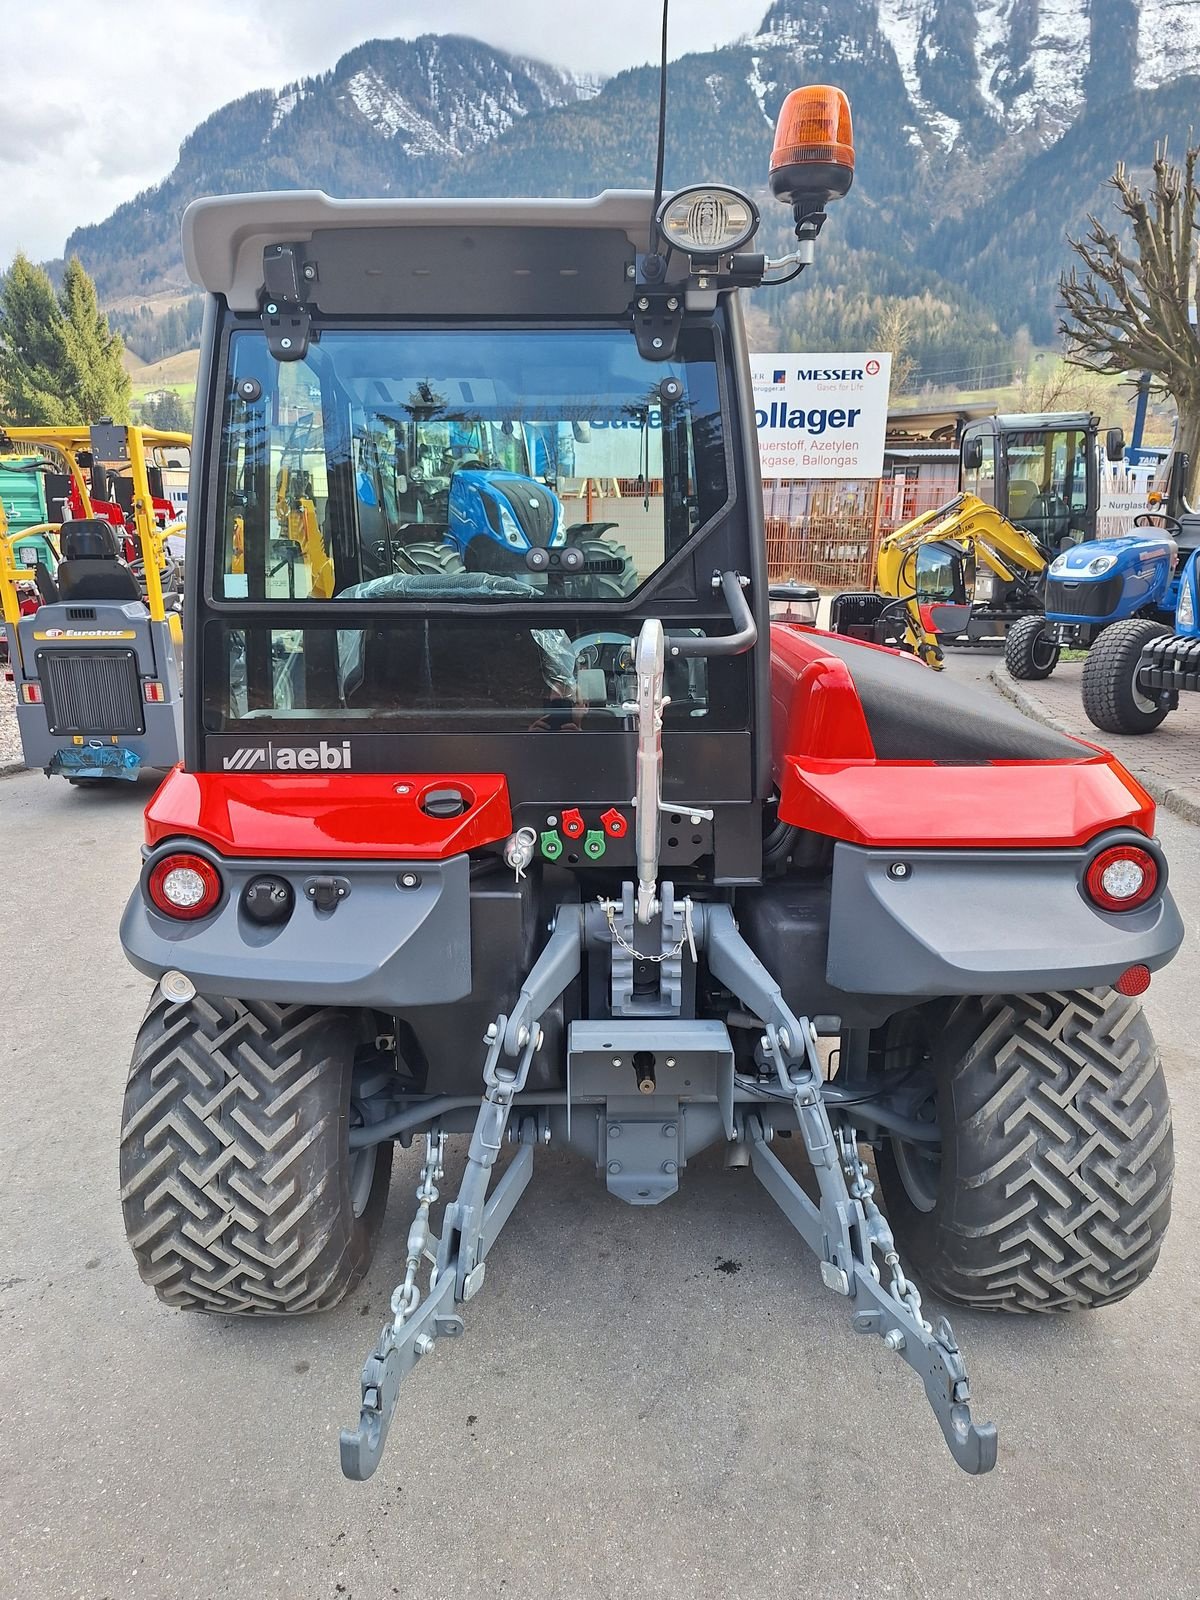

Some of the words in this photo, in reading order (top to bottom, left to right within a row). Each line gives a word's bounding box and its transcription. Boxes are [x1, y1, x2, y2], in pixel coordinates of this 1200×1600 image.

[797, 369, 863, 381] MESSER
[753, 385, 786, 393] brugger.at
[816, 383, 837, 392] Gases
[839, 383, 849, 391] for
[851, 383, 864, 391] Life
[755, 402, 861, 435] ollager
[810, 440, 859, 453] Azetylen
[762, 456, 798, 467] kgase,
[802, 455, 858, 467] Ballongas
[66, 629, 124, 637] Eurotrac
[276, 740, 352, 770] aebi
